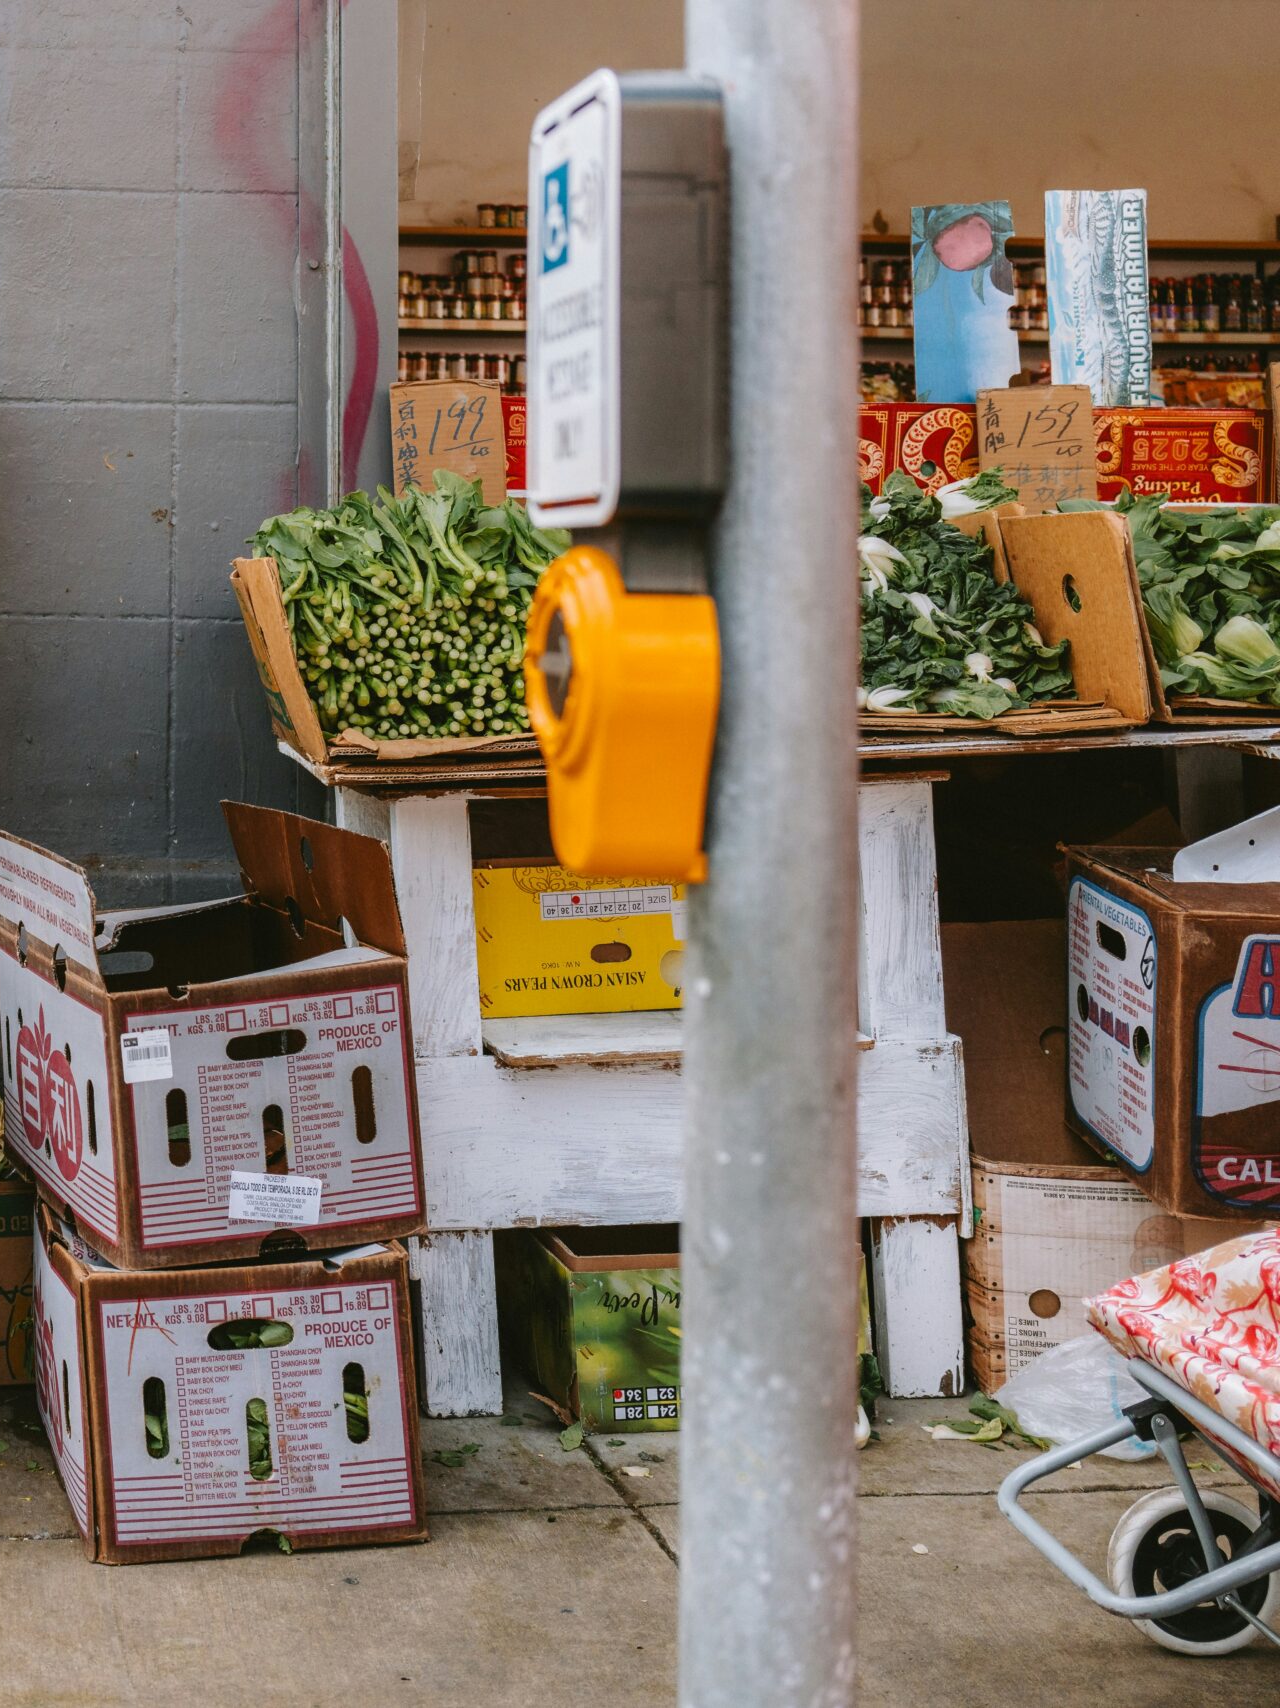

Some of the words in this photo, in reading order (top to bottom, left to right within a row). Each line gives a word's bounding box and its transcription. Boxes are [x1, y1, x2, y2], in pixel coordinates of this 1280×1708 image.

[1133, 437, 1209, 461] 2025
[1131, 463, 1157, 471] SNAKE
[1159, 463, 1174, 471] THE
[1175, 463, 1186, 471] OF
[1188, 463, 1209, 471] YEAR
[1133, 475, 1201, 498] Packing
[39, 875, 76, 908] REFRIGERATED
[632, 903, 641, 911] 20
[647, 895, 667, 904] SIZE
[546, 907, 556, 915] 40
[1103, 904, 1147, 937] VEGETABLES
[58, 918, 91, 948] VEGETABLES
[541, 962, 560, 970] 10KG
[505, 976, 547, 992] PEARS
[551, 973, 603, 988] CROWN
[606, 971, 646, 987] ASIAN
[195, 1015, 213, 1025] LBS.
[215, 1013, 224, 1023] 20
[259, 1009, 268, 1018] 25
[304, 1002, 321, 1013] LBS.
[323, 1001, 332, 1010] 30
[366, 995, 375, 1004] 35
[187, 1025, 206, 1035] KGS.
[208, 1023, 226, 1033] 9.08
[248, 1018, 269, 1028] 11.35
[292, 1013, 311, 1023] KGS.
[312, 1010, 333, 1020] 13.62
[354, 1005, 375, 1015] 15.89
[318, 1023, 376, 1041] PRODUCE
[381, 1020, 398, 1033] OF
[336, 1036, 382, 1052] MEXICO
[302, 1123, 321, 1132] YELLOW
[173, 1305, 192, 1315] LBS.
[194, 1303, 204, 1313] 20
[241, 1301, 251, 1310] 25
[289, 1296, 308, 1306] LBS.
[310, 1295, 320, 1304] 30
[356, 1291, 366, 1301] 35
[165, 1315, 185, 1325] KGS.
[187, 1314, 205, 1323] 9.08
[230, 1310, 252, 1320] 11.35
[277, 1307, 296, 1317] KGS.
[298, 1305, 320, 1315] 13.62
[345, 1301, 367, 1311] 15.89
[106, 1314, 131, 1329] NET
[304, 1319, 368, 1337] PRODUCE
[373, 1317, 392, 1330] OF
[1018, 1318, 1039, 1327] LIMES
[324, 1332, 375, 1349] MEXICO
[1018, 1328, 1047, 1338] LEMONS
[626, 1389, 642, 1401] 36
[659, 1387, 675, 1400] 32
[626, 1406, 643, 1418] 28
[660, 1404, 676, 1417] 24
[191, 1440, 210, 1448] SWEET
[223, 1438, 239, 1446] CHOY
[193, 1472, 213, 1480] GREEN
